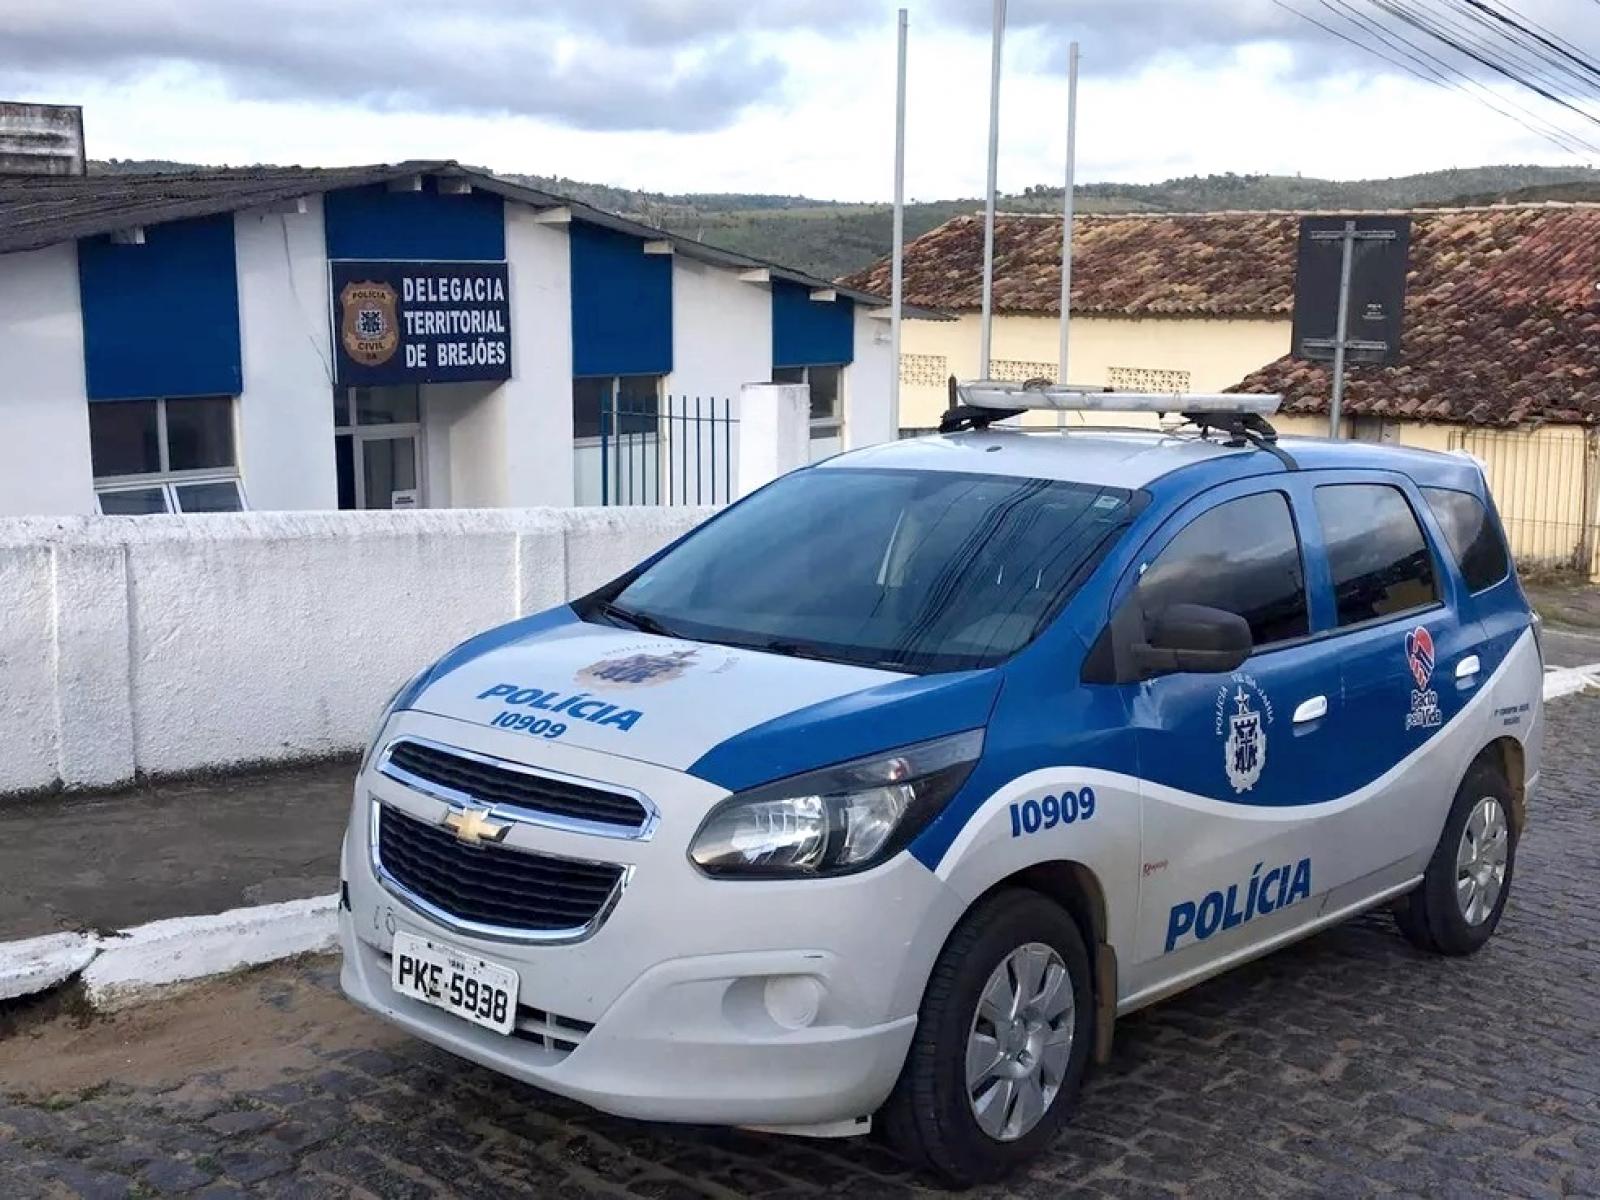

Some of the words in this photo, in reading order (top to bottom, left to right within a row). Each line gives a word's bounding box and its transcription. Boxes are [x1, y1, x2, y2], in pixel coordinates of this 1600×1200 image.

[402, 277, 505, 301] DELEGACIA
[403, 310, 505, 335] TERRITORIAL
[357, 342, 385, 351] CIVIL
[406, 344, 427, 368] DE
[438, 338, 505, 366] BREJÕES
[477, 683, 643, 732] POLÍCIA
[490, 711, 567, 738] 10909
[1010, 786, 1095, 837] 10909
[1164, 858, 1311, 955] POLÍCIA
